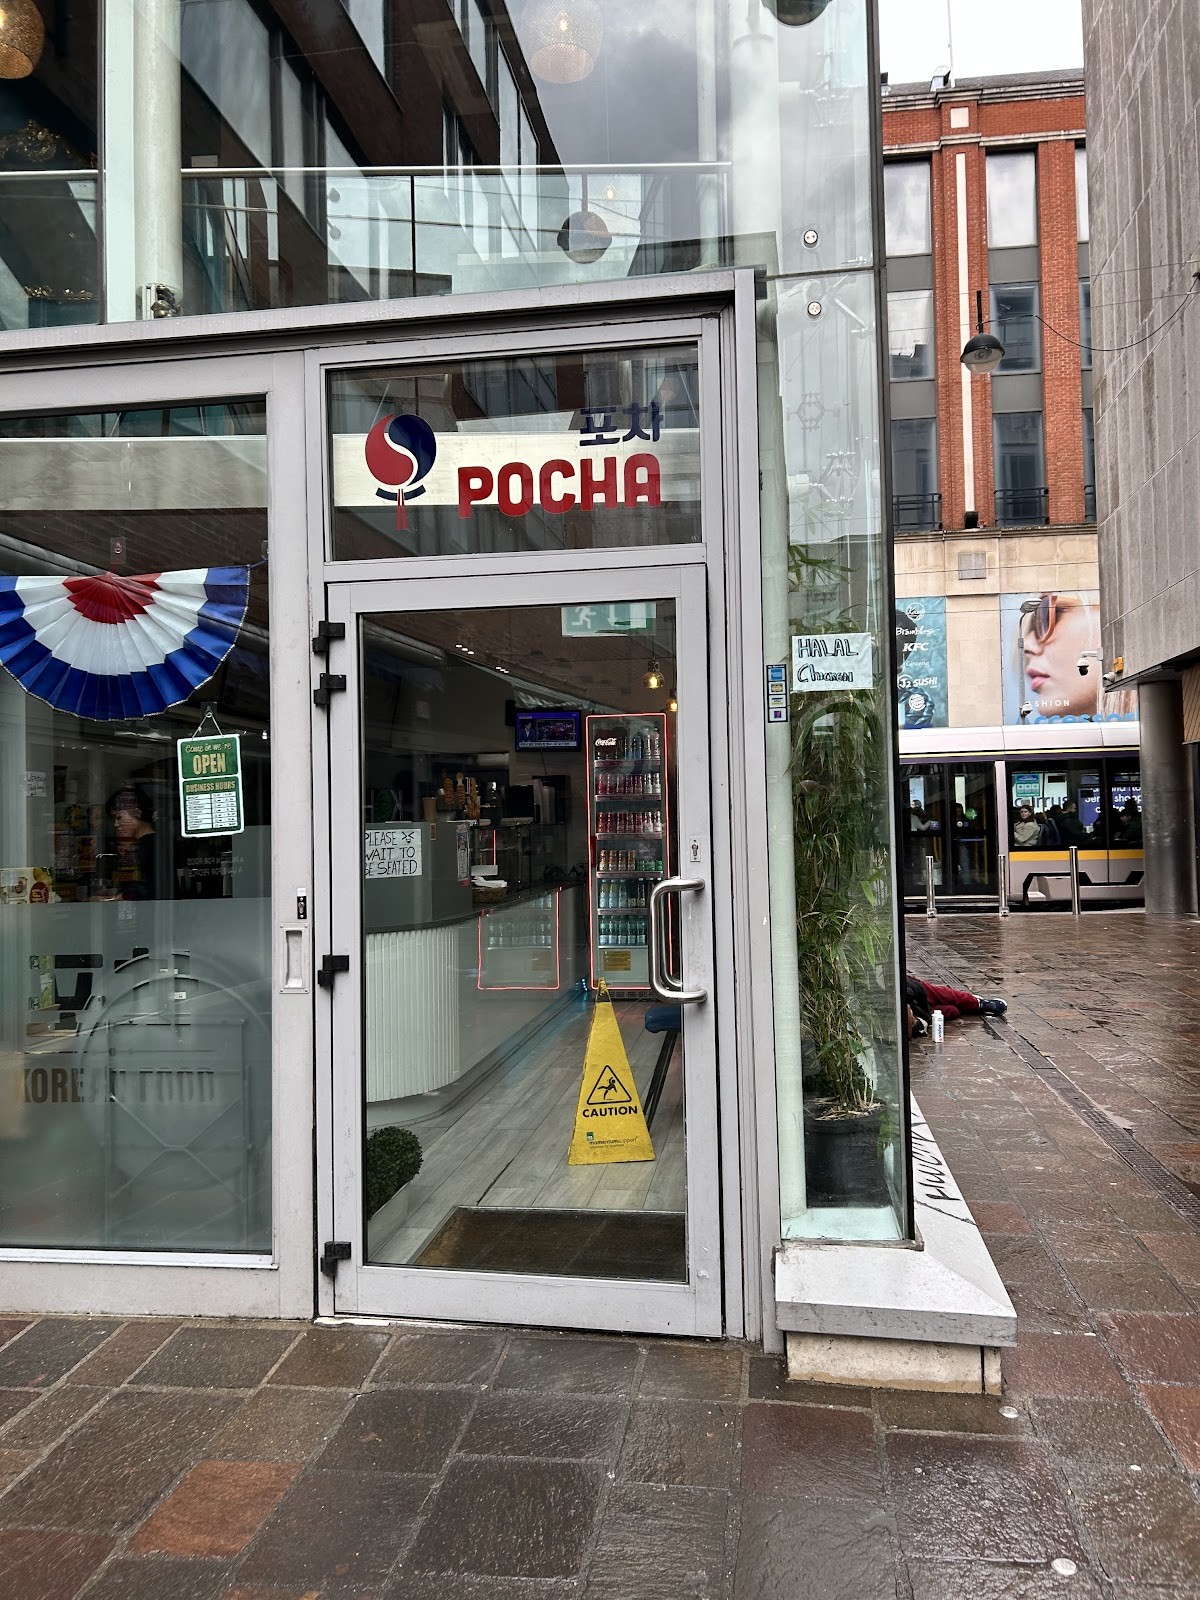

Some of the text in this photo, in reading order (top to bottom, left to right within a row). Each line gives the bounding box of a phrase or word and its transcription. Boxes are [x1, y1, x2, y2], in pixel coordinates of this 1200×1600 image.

[579, 402, 664, 446] 포차
[458, 453, 661, 519] POCHA
[797, 638, 859, 658] HALAL
[903, 642, 929, 651] KFC
[913, 676, 938, 687] SUSHI
[186, 744, 204, 753] Come
[204, 743, 212, 752] in
[595, 738, 617, 747] Coca-Cola
[192, 753, 227, 775] OPEN
[185, 781, 236, 793] BUSINESS HOURS
[364, 831, 397, 846] PLEASE
[364, 846, 416, 860] WAIT TO
[377, 859, 418, 875] SEATED
[583, 1106, 638, 1117] CAUTION
